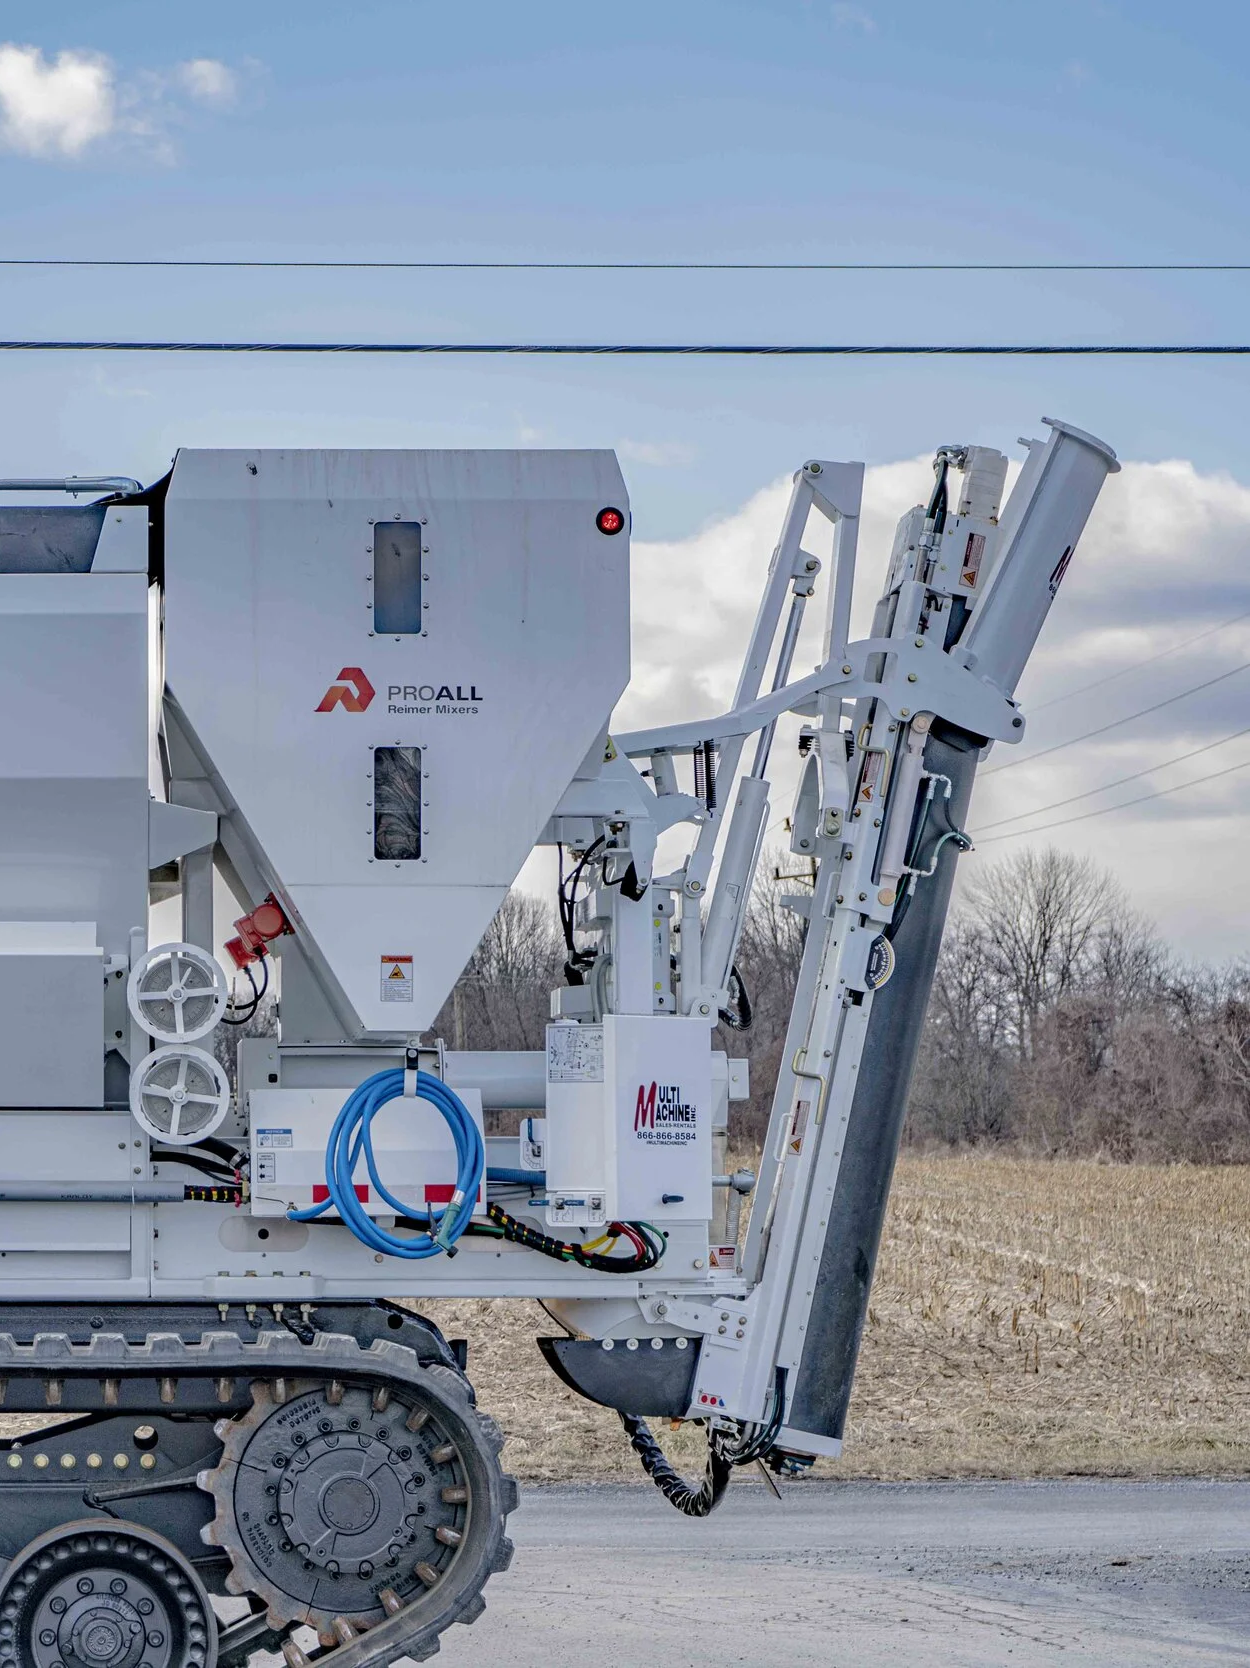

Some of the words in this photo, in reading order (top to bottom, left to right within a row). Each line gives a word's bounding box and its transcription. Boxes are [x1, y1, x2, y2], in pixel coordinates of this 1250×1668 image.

[388, 686, 483, 701] PROALL
[388, 705, 432, 714] Reimer
[436, 705, 479, 714] Mixers
[637, 1132, 696, 1140] 866-866-8584
